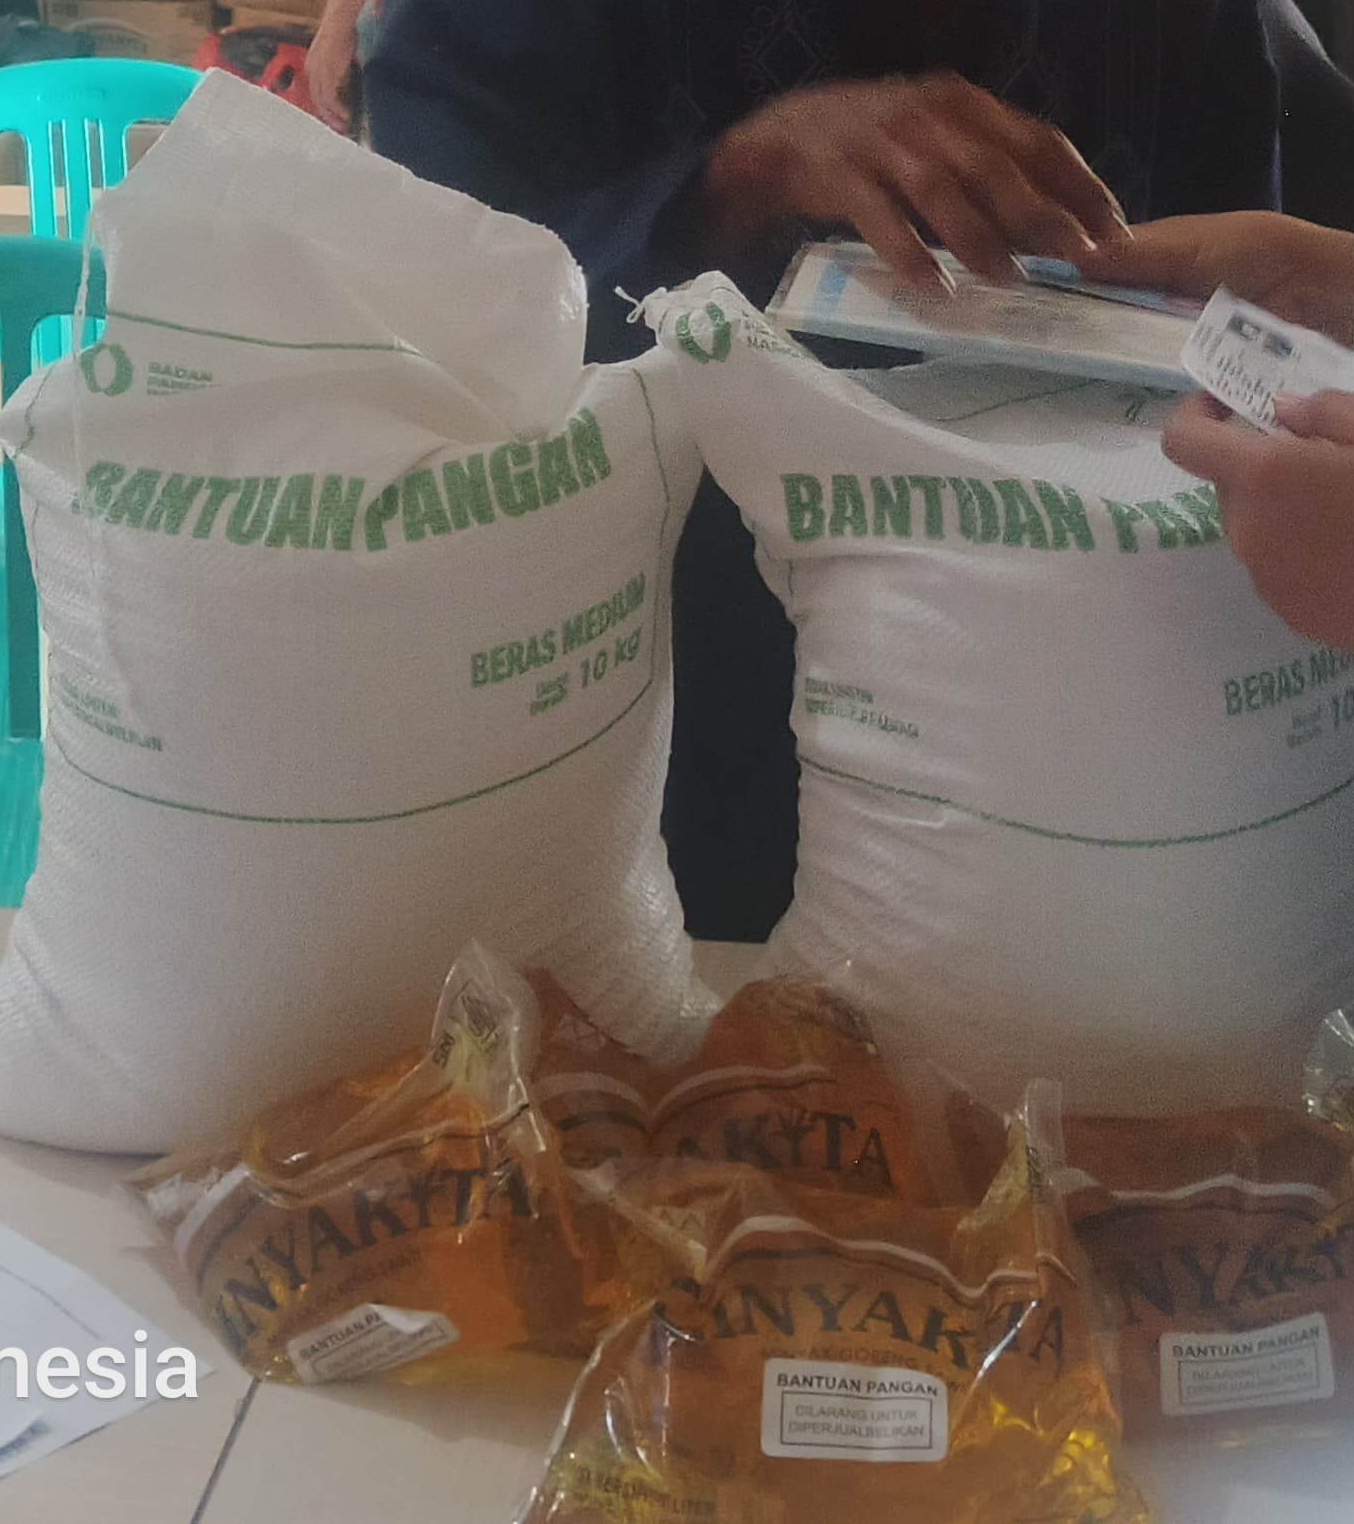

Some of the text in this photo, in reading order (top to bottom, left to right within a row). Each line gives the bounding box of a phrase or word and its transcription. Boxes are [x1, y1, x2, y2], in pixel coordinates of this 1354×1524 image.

[73, 407, 612, 552] BANTUAN PANGAN
[780, 472, 1097, 553] BANTUAN
[470, 570, 647, 690] BERAS MEDIUM
[580, 649, 609, 689] 10
[1224, 658, 1306, 717] BERAS
[1172, 1327, 1320, 1358] BANTUAN PANGAN
[776, 1372, 938, 1397] BANTUAN PANGAN
